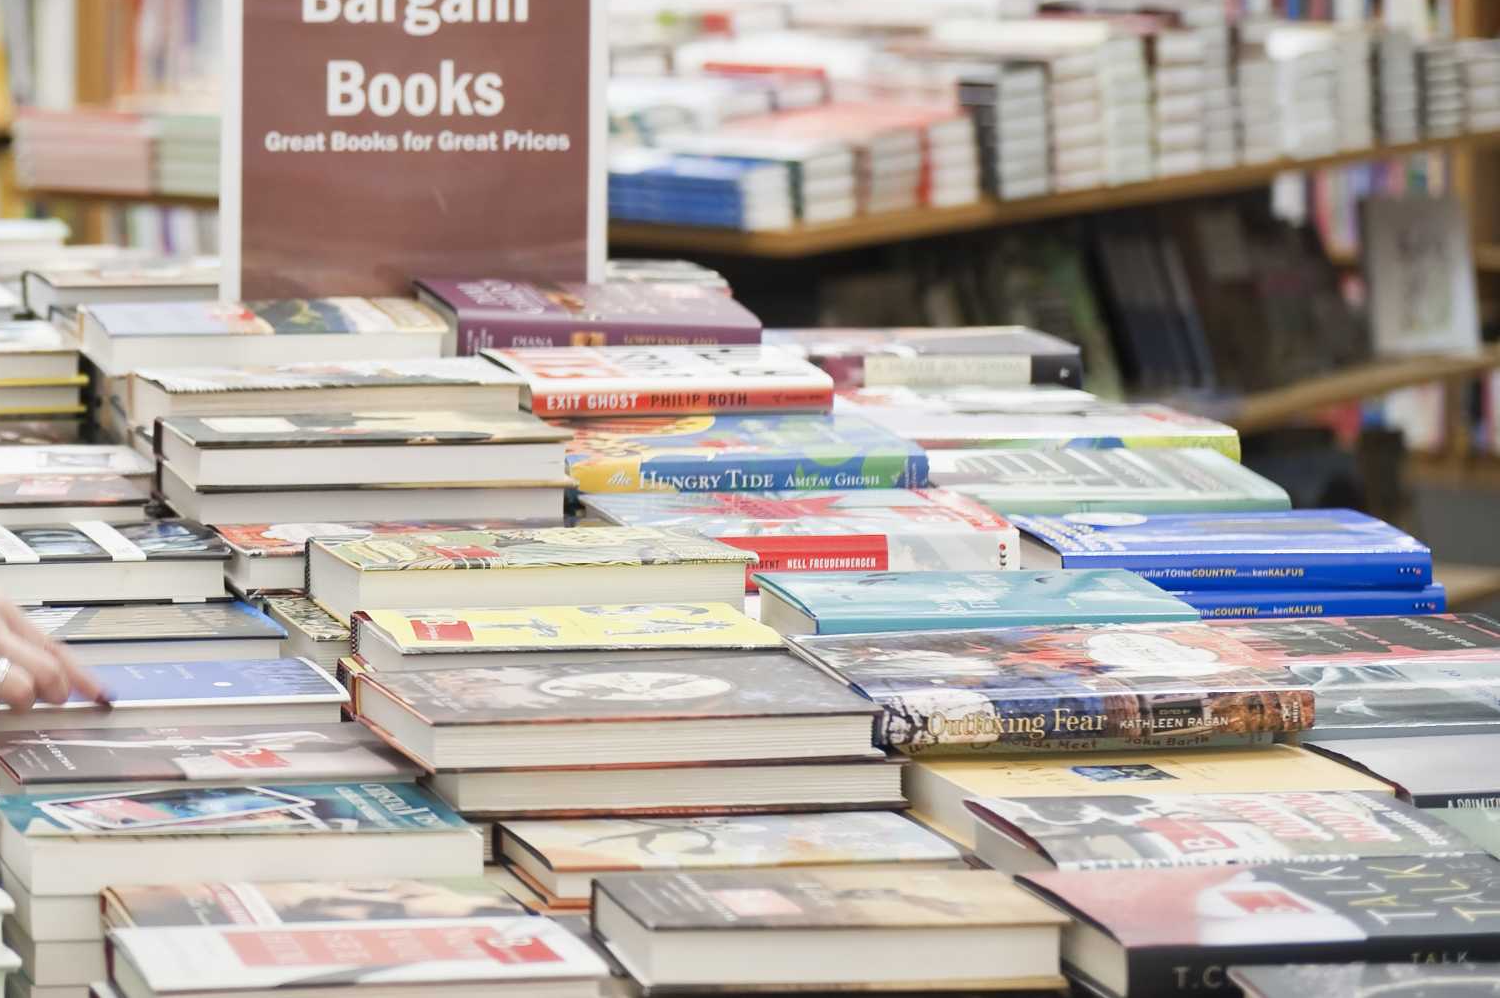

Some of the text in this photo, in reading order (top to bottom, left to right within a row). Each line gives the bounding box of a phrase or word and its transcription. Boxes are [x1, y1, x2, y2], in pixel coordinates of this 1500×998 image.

[327, 60, 505, 116] Books
[265, 130, 570, 152] Great Books for Great Prices
[546, 392, 747, 410] EXIT GHOST PHILIP ROTH
[638, 470, 721, 490] HUNGRY
[724, 468, 774, 488] TIDE
[784, 474, 831, 488] AMITAV
[834, 472, 880, 487] GHOSH
[787, 558, 806, 569] NELL
[808, 557, 877, 569] FREUDENBERGER
[926, 707, 1108, 739] Outfoxing Fear
[1119, 715, 1229, 729] KATHLEEN RAGAN
[1172, 965, 1225, 991] T.C
